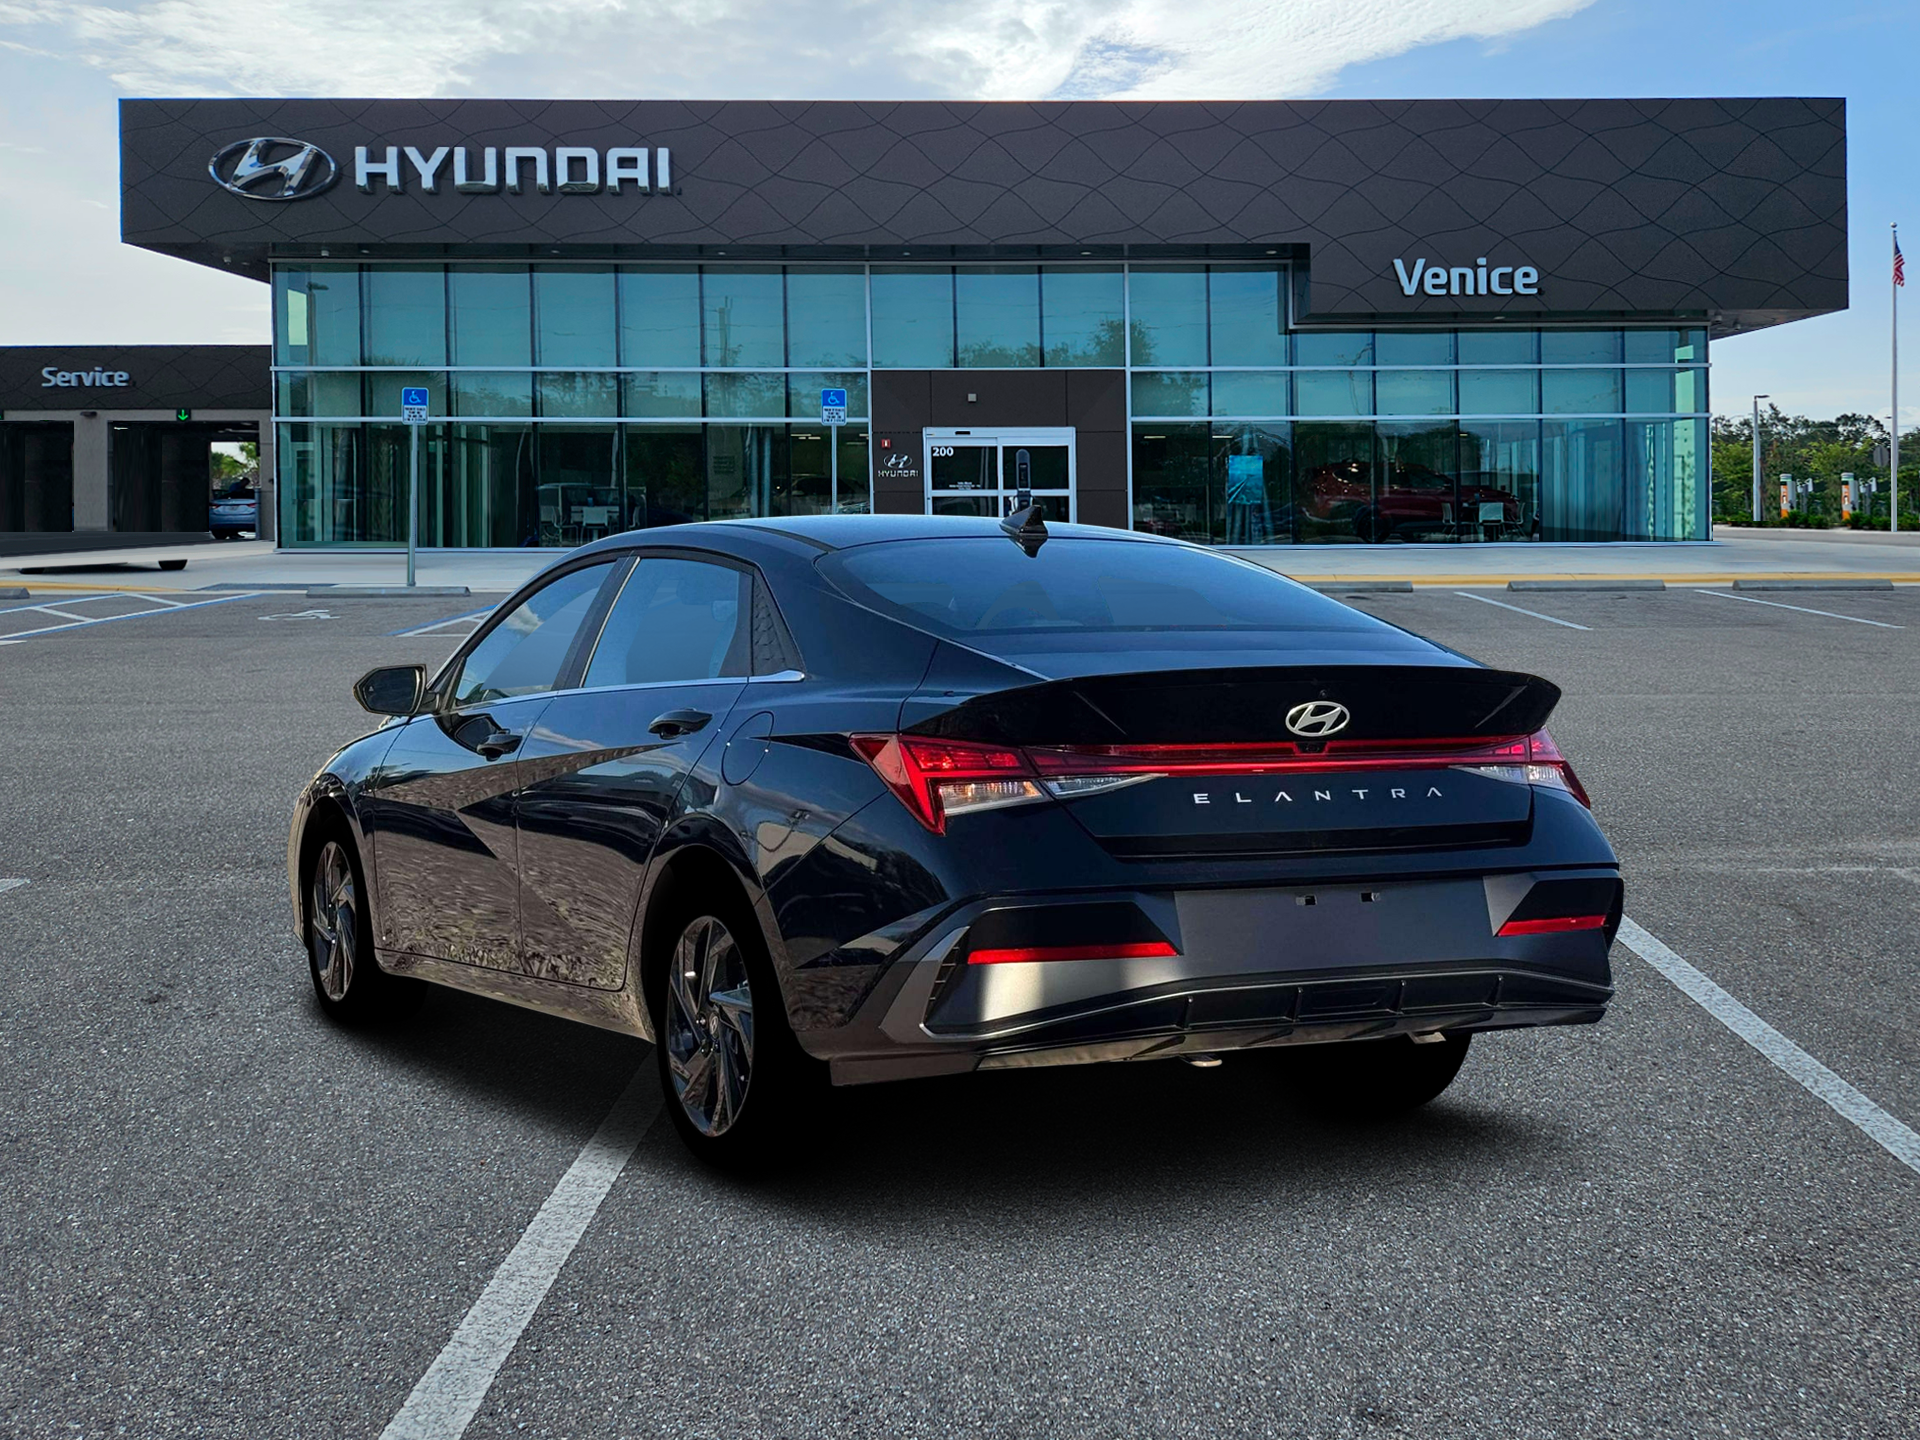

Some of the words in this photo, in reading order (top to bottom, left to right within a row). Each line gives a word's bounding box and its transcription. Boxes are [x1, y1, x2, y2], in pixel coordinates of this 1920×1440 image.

[355, 146, 670, 194] HYUNDAI
[1393, 257, 1539, 295] Venice
[41, 366, 130, 387] Service
[932, 446, 954, 457] 200
[877, 469, 919, 478] HYUNDAI
[1193, 786, 1442, 804] ELANTRA
